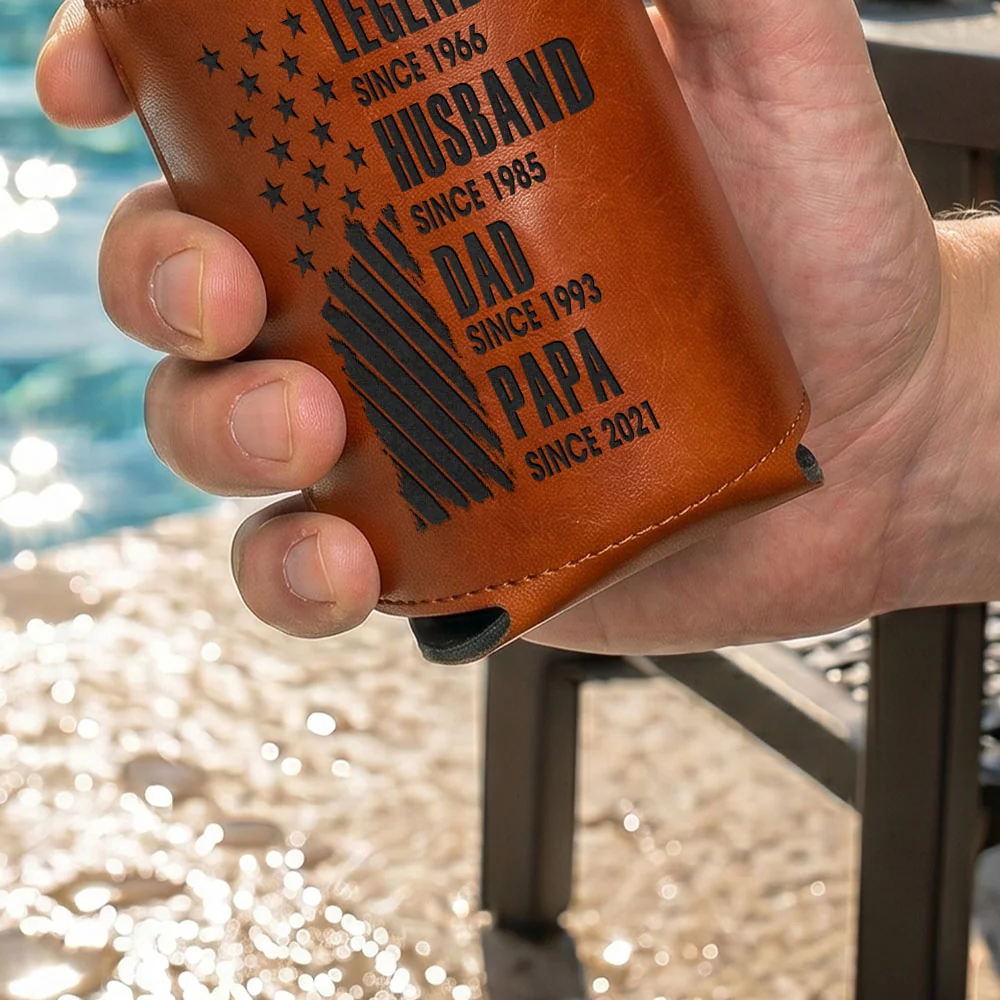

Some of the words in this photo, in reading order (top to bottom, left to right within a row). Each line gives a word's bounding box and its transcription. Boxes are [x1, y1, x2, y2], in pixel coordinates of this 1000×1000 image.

[350, 50, 427, 107] SINCE
[423, 23, 489, 73] 1966
[370, 36, 595, 193] HUSBAND
[409, 178, 487, 235] SINCE
[483, 151, 547, 201] 1985
[429, 219, 535, 321] DAD
[465, 298, 543, 356] SINCE
[539, 272, 603, 322] 1993
[485, 327, 625, 441] PAPA
[524, 425, 603, 483] SINCE
[600, 400, 661, 450] 2021
